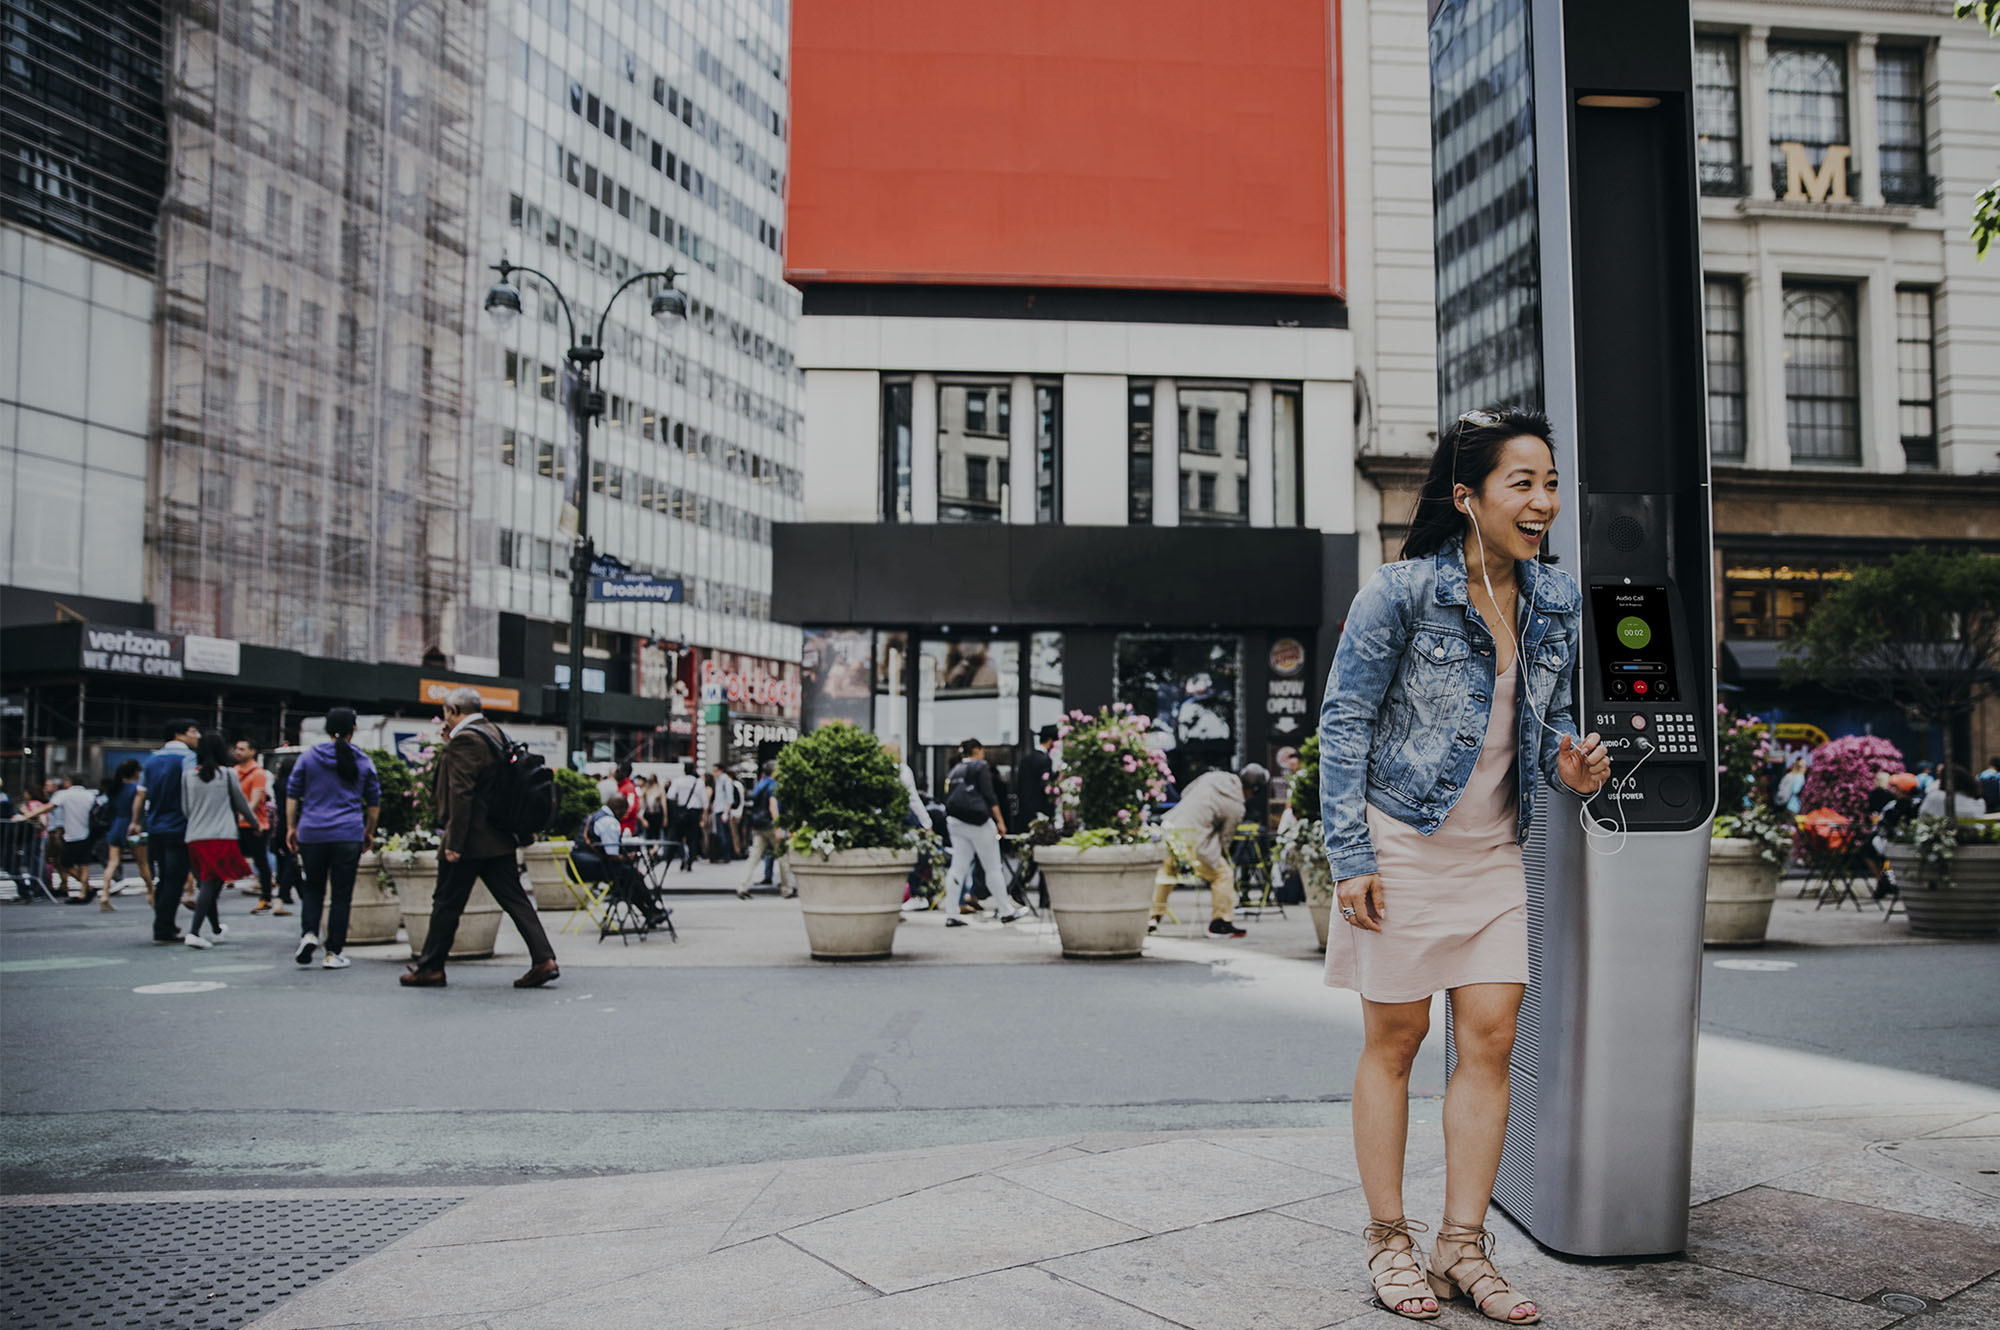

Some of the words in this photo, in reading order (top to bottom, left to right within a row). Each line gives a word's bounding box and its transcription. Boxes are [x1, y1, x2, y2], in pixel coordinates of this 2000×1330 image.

[1780, 142, 1852, 203] M
[602, 581, 673, 601] Broadway
[88, 630, 171, 657] verizon
[83, 650, 109, 669] WE
[110, 653, 141, 673] ARE
[143, 657, 183, 678] OPEN
[1269, 680, 1304, 695] NOW
[1266, 698, 1307, 714] OPEN
[1596, 714, 1616, 725] 911
